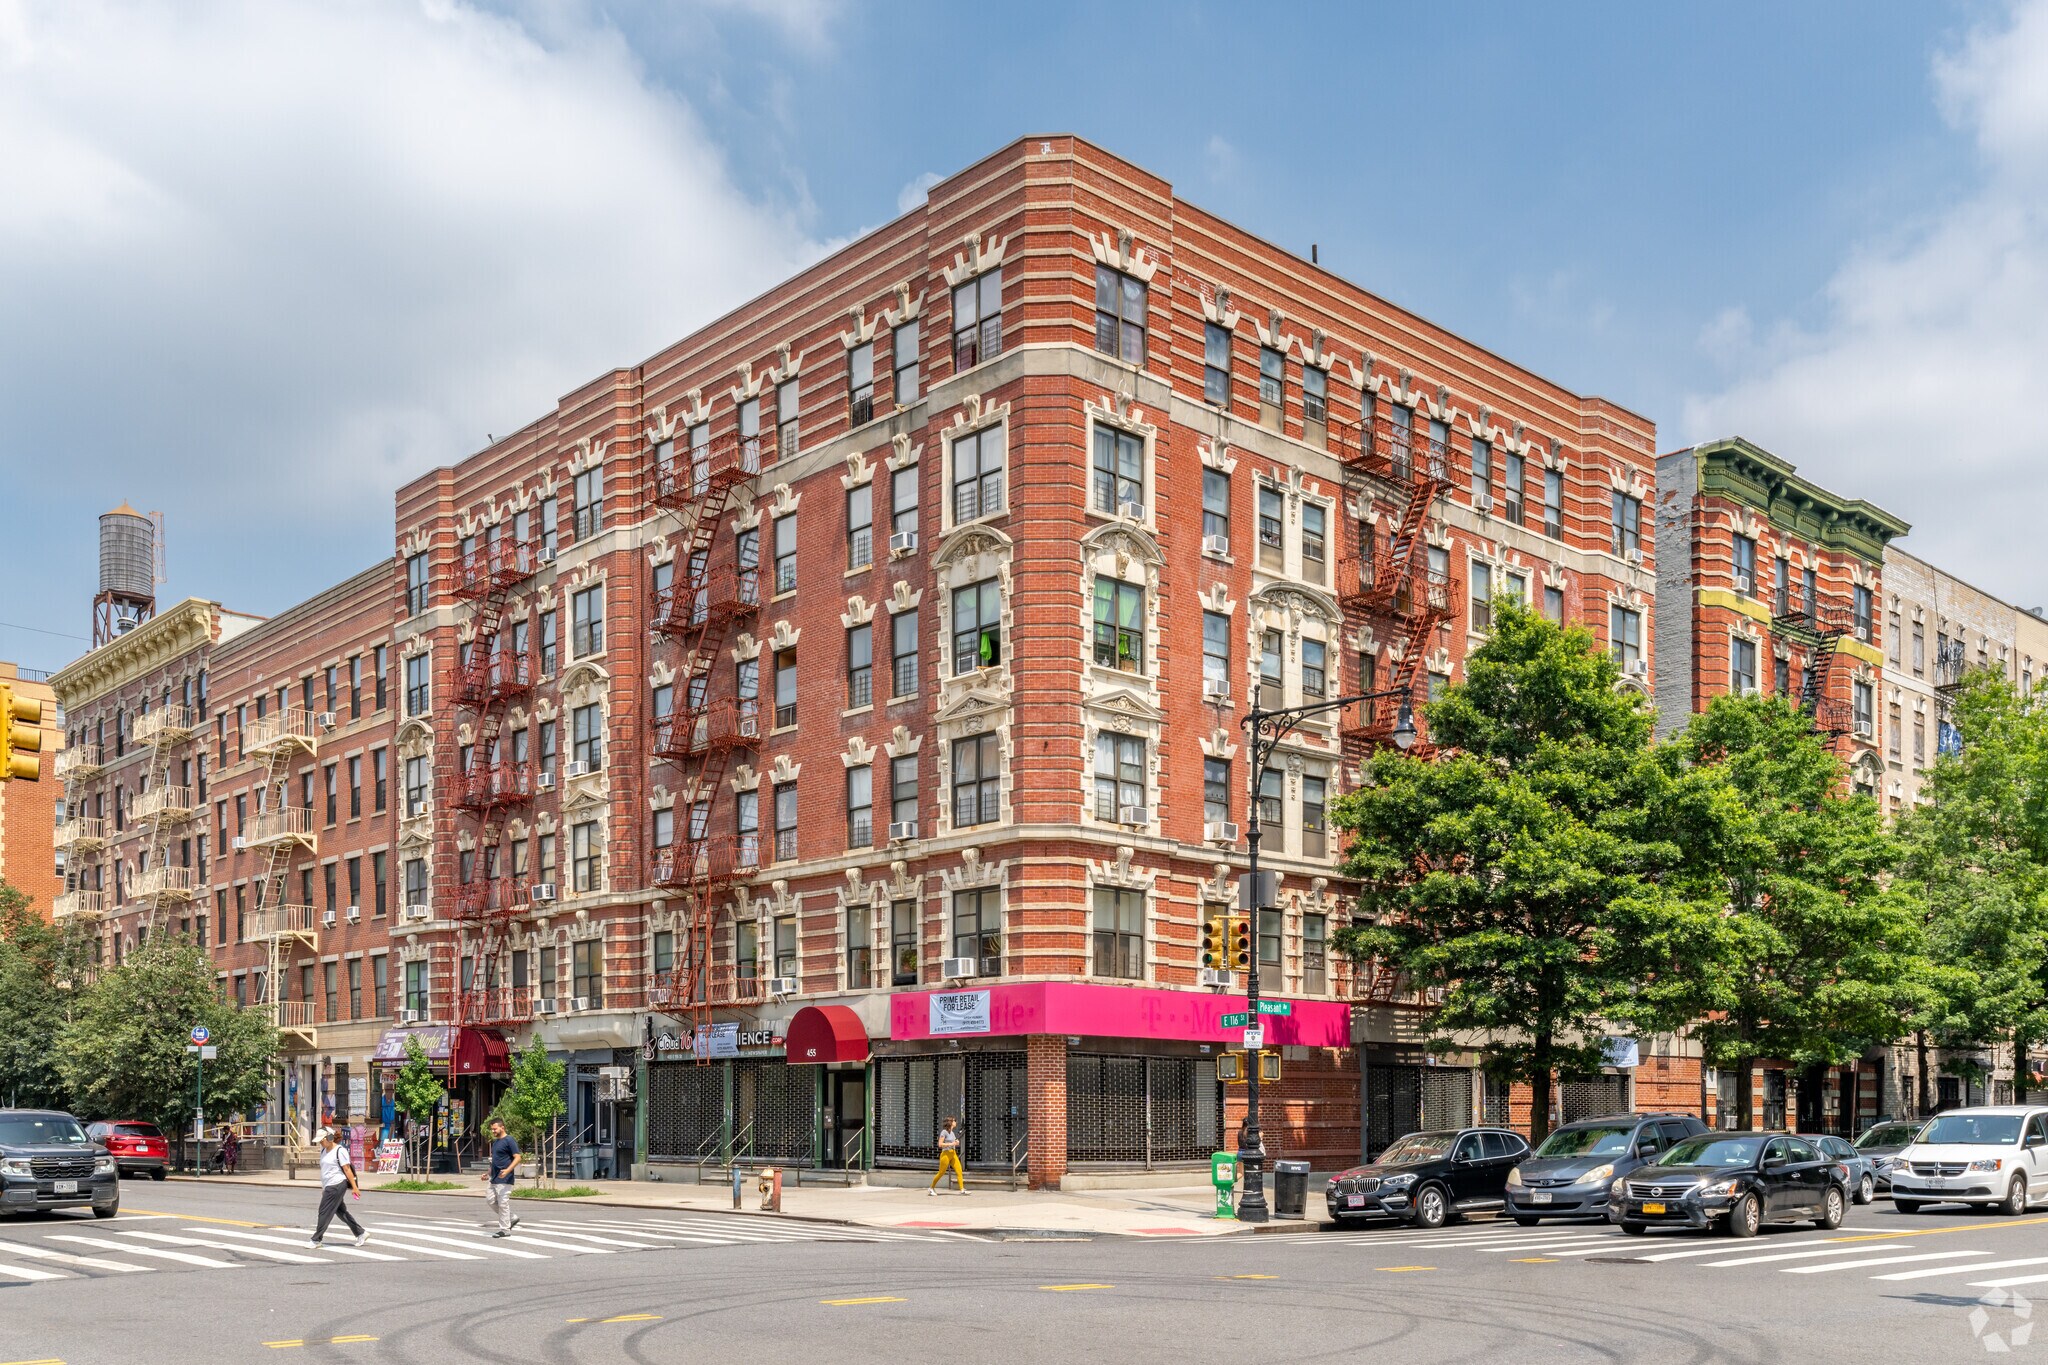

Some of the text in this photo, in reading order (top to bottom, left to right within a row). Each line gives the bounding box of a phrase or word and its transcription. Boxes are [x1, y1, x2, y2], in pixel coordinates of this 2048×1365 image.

[940, 994, 979, 1004] PRIME RETAIL
[957, 1002, 975, 1010] LEASE
[1259, 1002, 1281, 1012] Pleasant
[1224, 1016, 1227, 1026] E
[1230, 1015, 1238, 1025] 116
[658, 1030, 692, 1050] Cloud 16
[806, 1048, 816, 1057] 455
